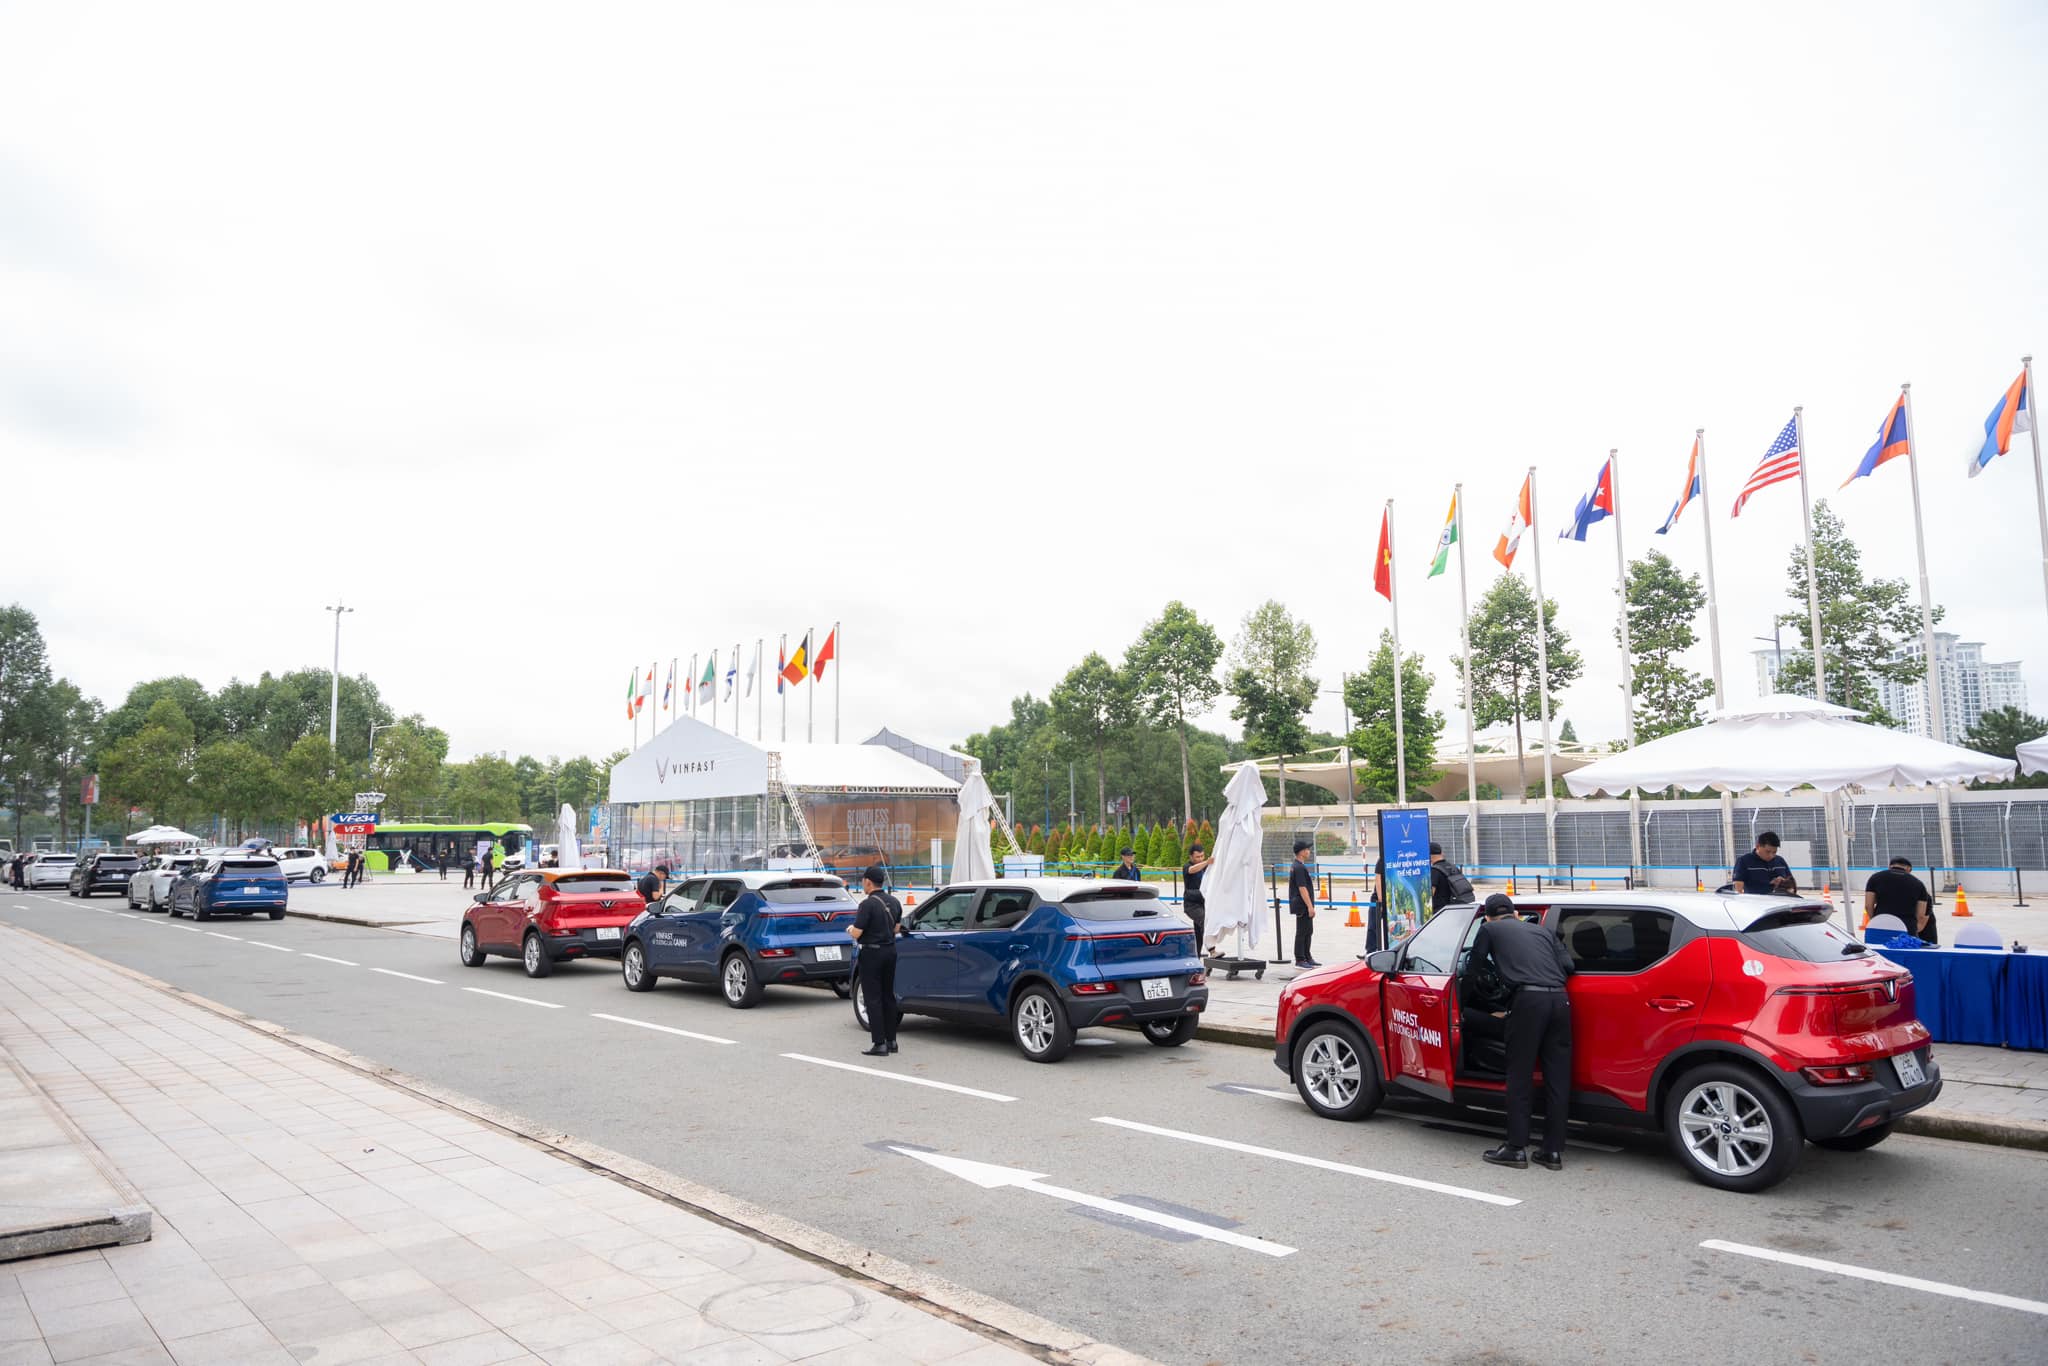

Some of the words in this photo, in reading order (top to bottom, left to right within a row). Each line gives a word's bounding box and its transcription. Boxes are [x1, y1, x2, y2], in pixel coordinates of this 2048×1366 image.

[672, 760, 715, 775] VINFAST
[339, 814, 376, 823] VFe34
[344, 825, 366, 833] VF5
[847, 823, 912, 851] TOGETHER
[1391, 1007, 1418, 1028] VINFAST
